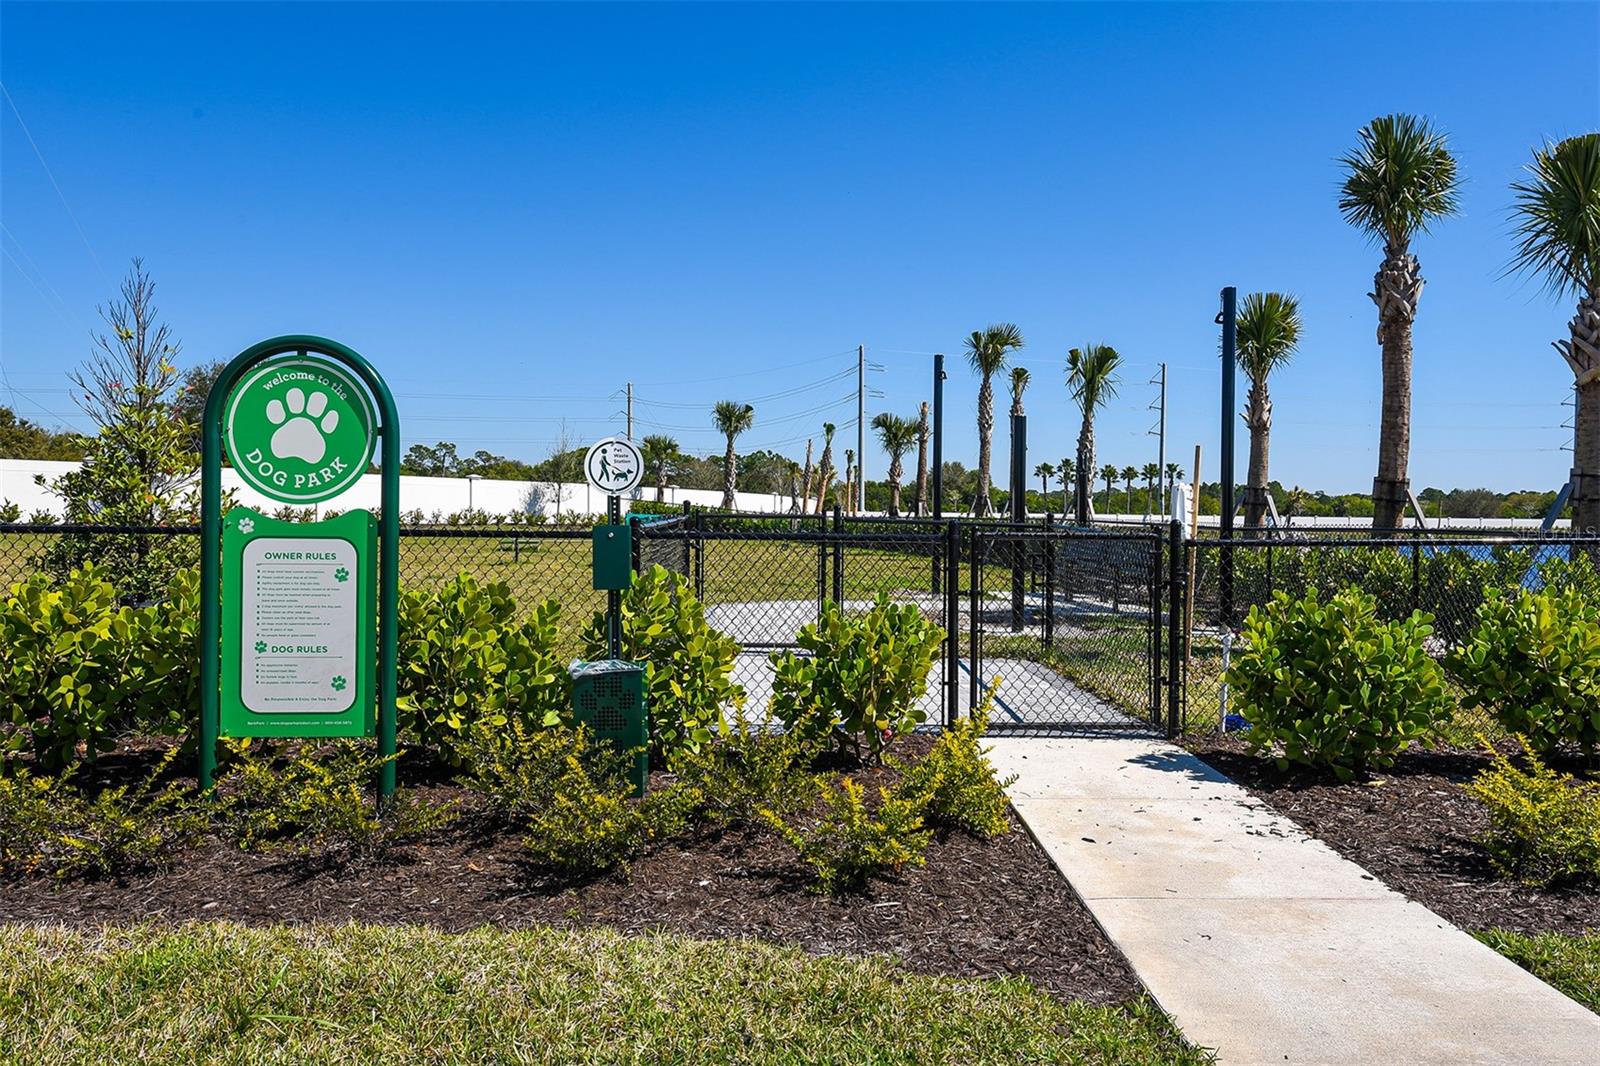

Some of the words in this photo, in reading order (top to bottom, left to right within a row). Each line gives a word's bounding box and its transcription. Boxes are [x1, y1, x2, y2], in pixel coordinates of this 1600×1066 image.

[262, 371, 315, 391] welcome
[318, 374, 330, 386] to
[331, 381, 347, 401] the
[245, 448, 288, 487] DOG
[294, 456, 348, 488] PARK
[264, 552, 302, 560] OWNER
[306, 552, 337, 560] RULES
